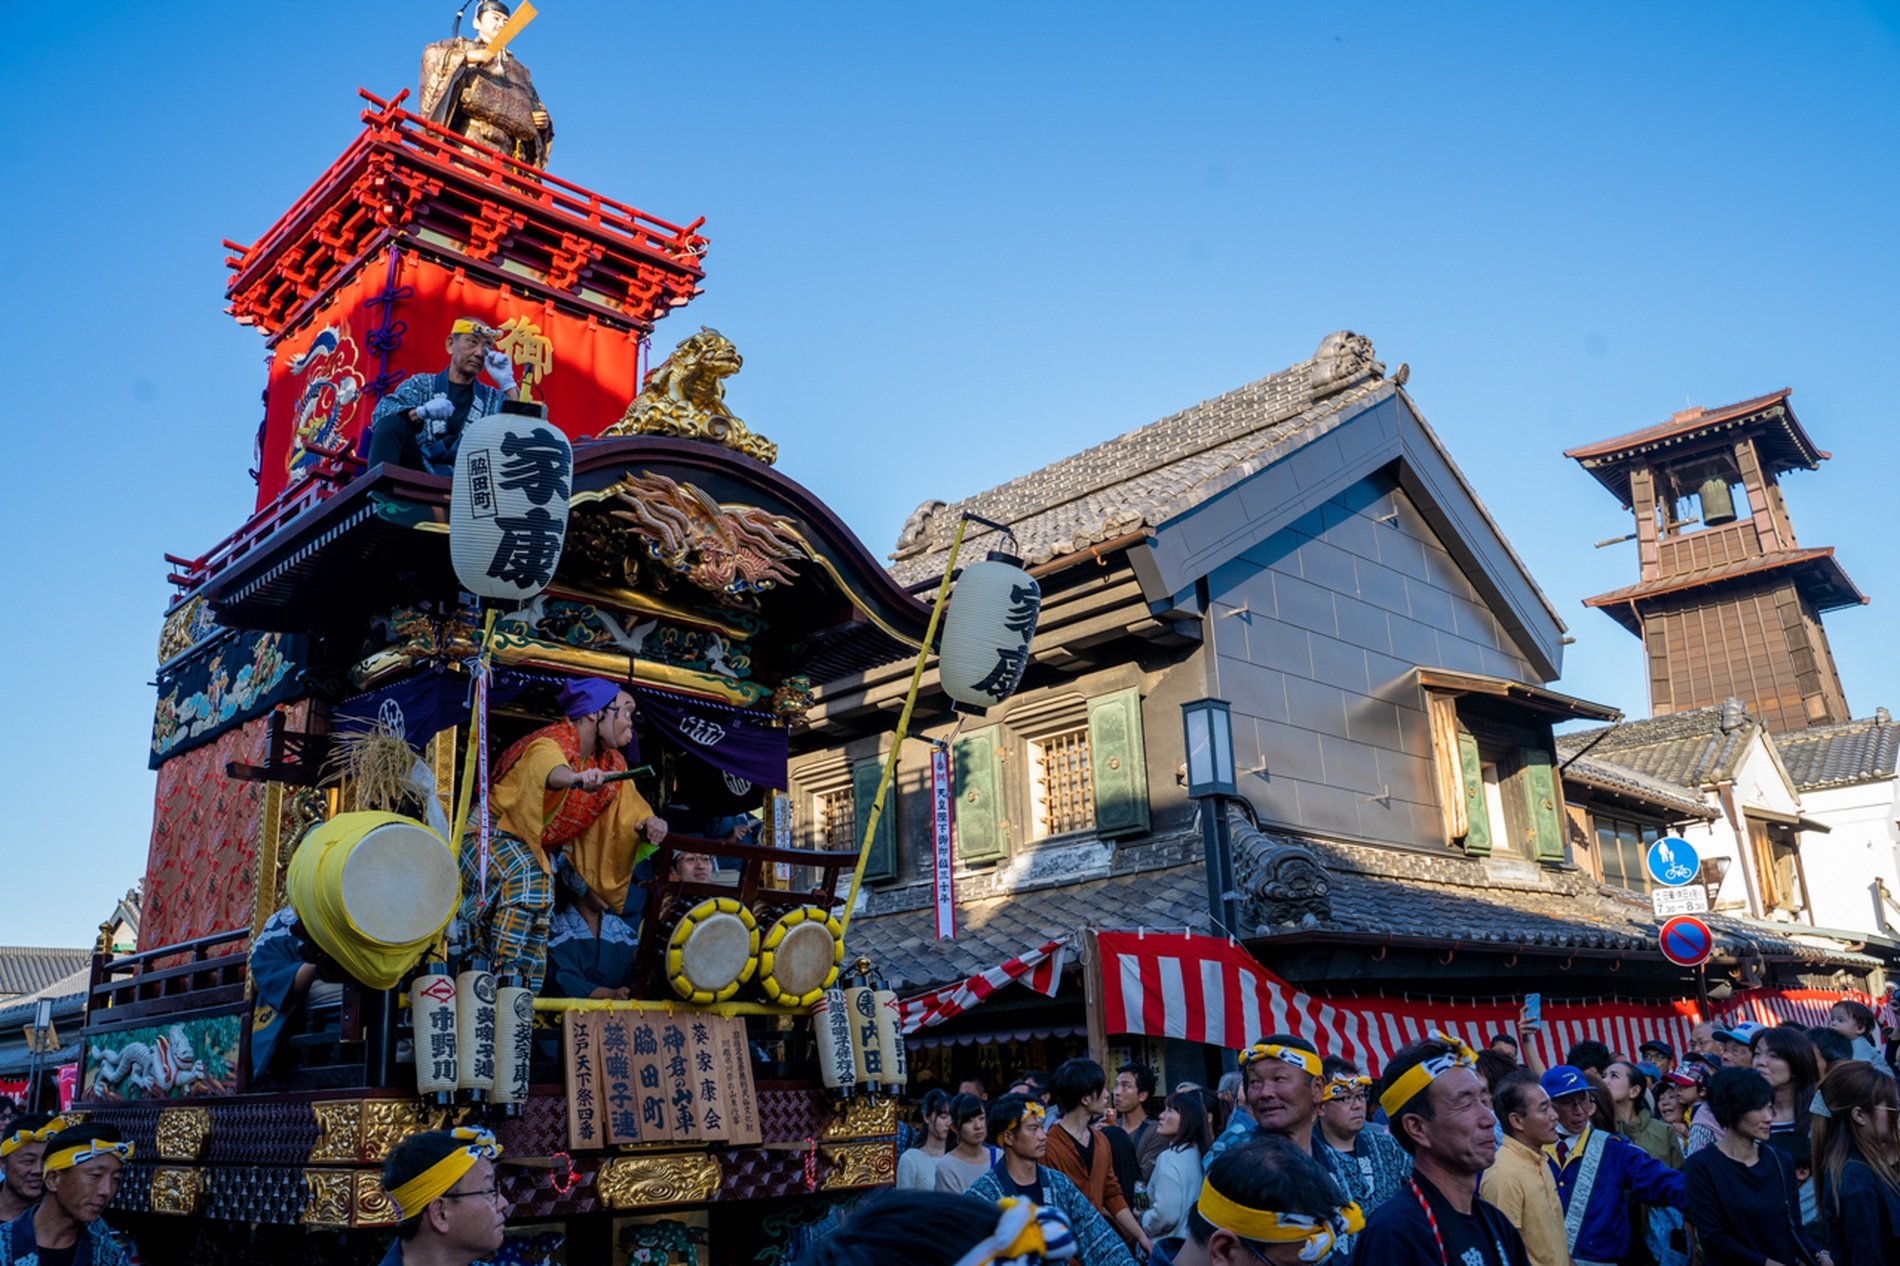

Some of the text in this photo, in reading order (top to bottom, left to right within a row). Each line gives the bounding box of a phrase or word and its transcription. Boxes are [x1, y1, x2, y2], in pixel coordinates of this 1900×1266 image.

[469, 456, 492, 511] 脇田町
[486, 427, 572, 590] 家康
[429, 1006, 458, 1083] 市野川
[573, 1023, 596, 1140] 江戸天下祭四番
[602, 1021, 639, 1139] 葵囃子連
[633, 1024, 665, 1130] 脇田町
[662, 1024, 696, 1135] 神君の山車
[691, 1022, 722, 1130] 葵家康会
